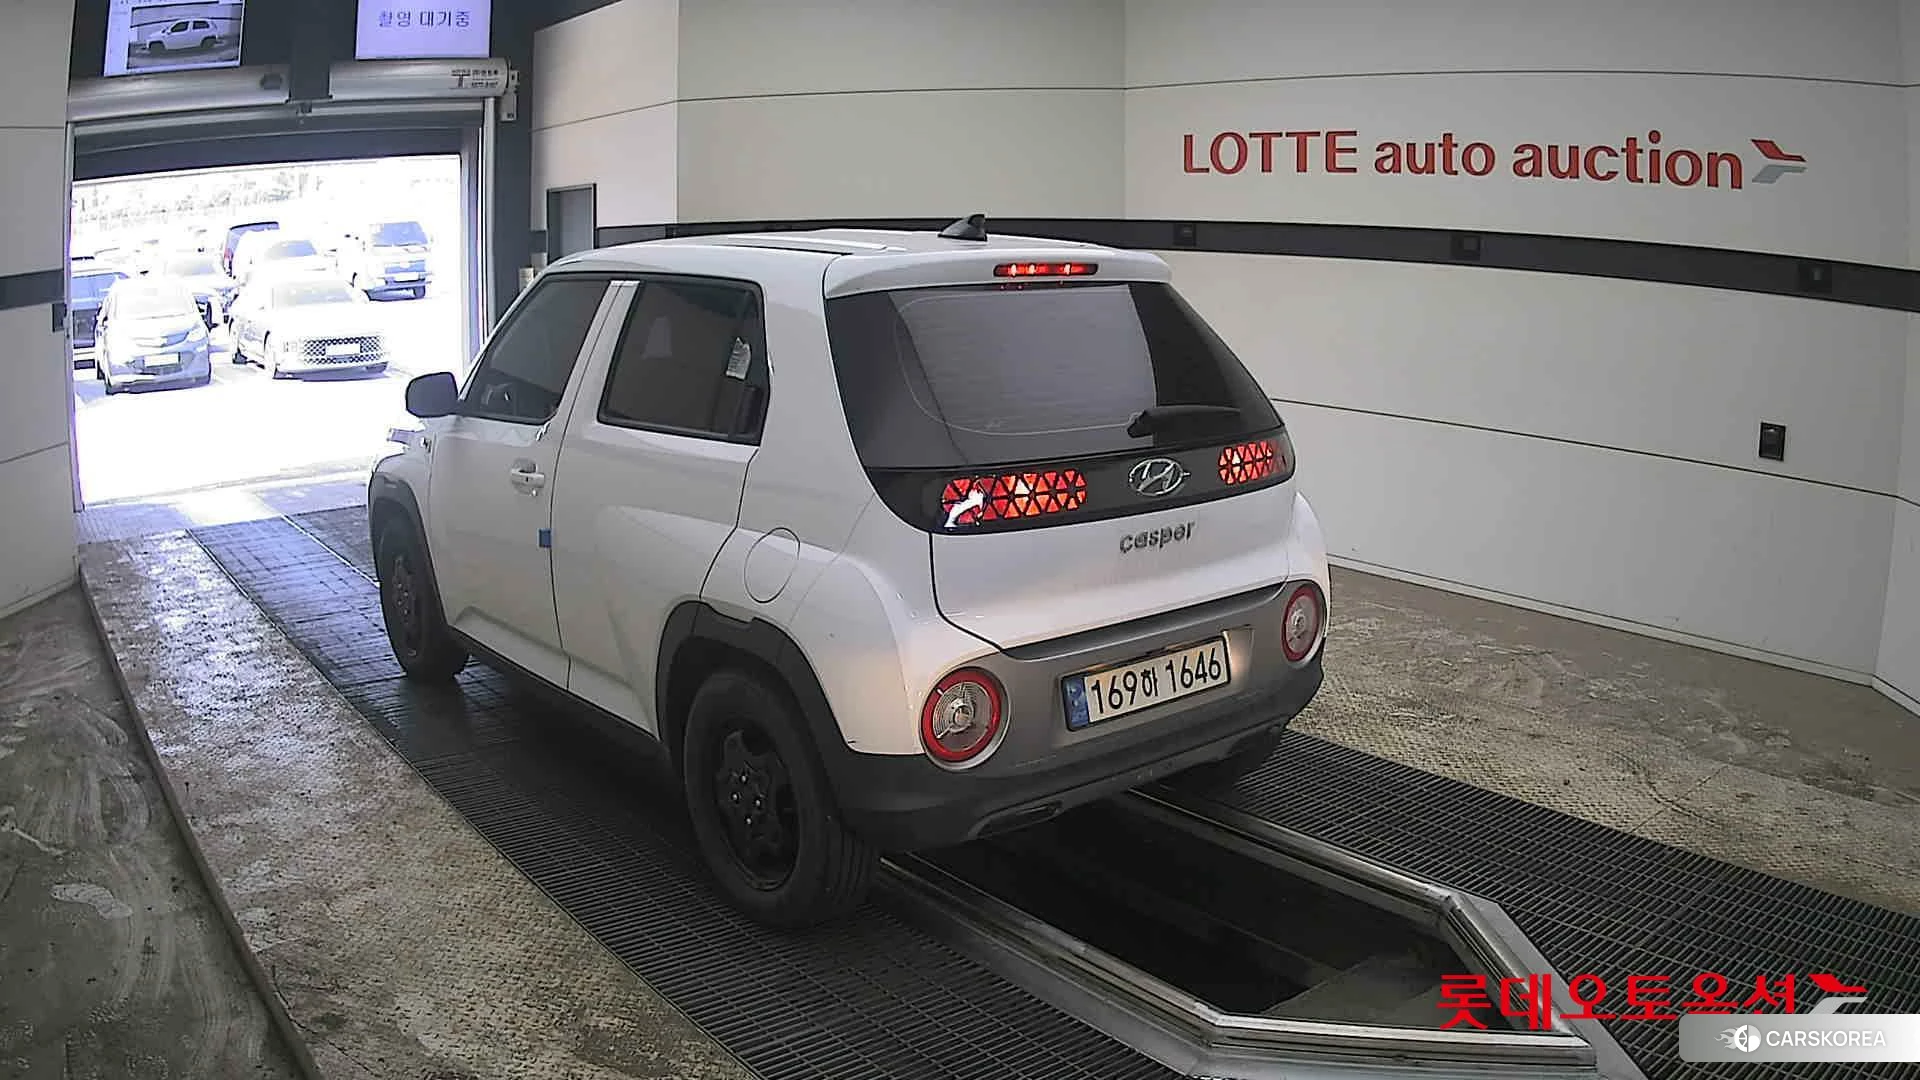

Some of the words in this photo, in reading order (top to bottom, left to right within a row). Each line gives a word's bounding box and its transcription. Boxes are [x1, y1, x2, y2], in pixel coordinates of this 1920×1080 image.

[1183, 130, 1358, 175] LOTTE
[1374, 132, 1496, 177] auto
[1512, 129, 1743, 189] auction
[1119, 521, 1196, 554] casper
[1165, 647, 1222, 694] 1646
